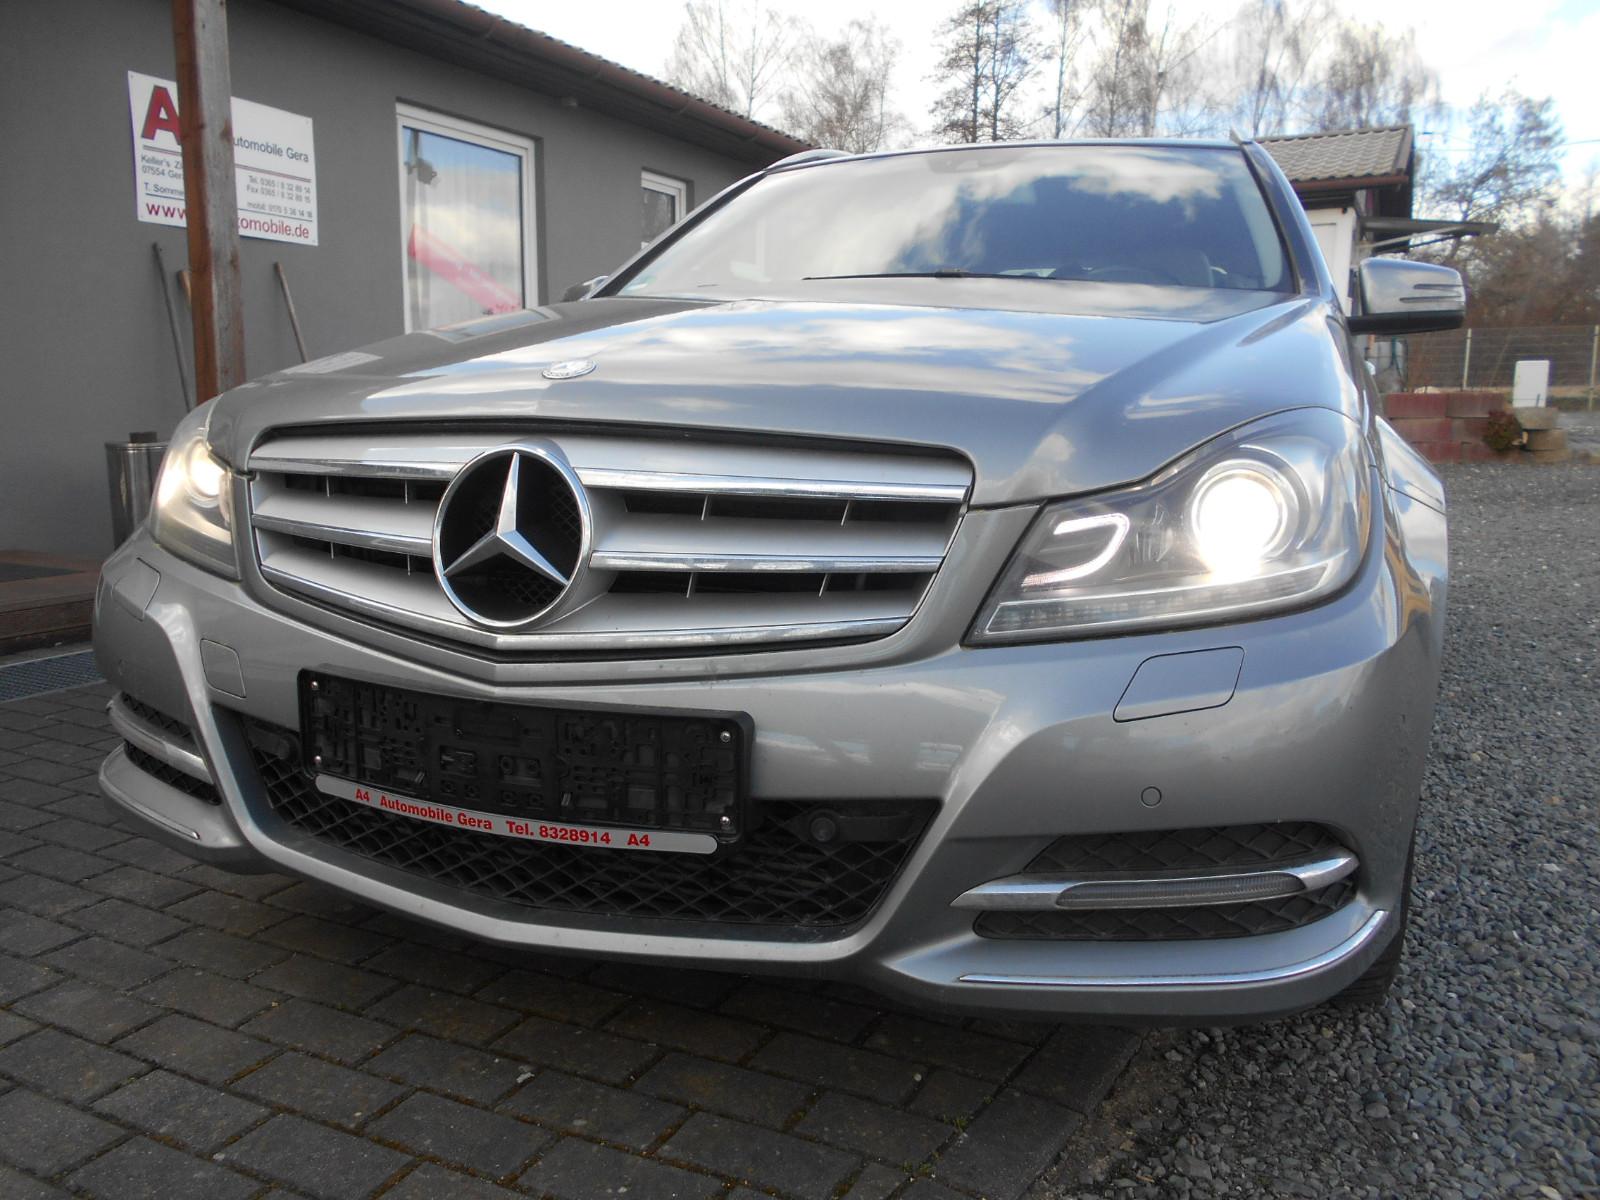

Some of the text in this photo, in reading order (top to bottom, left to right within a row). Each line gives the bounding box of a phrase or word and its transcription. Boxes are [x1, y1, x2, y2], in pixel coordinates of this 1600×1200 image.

[286, 146, 309, 163] Gera
[168, 169, 184, 180] Ger
[355, 788, 651, 847] A4 Automobile Gera Tel. 8328914 A4
